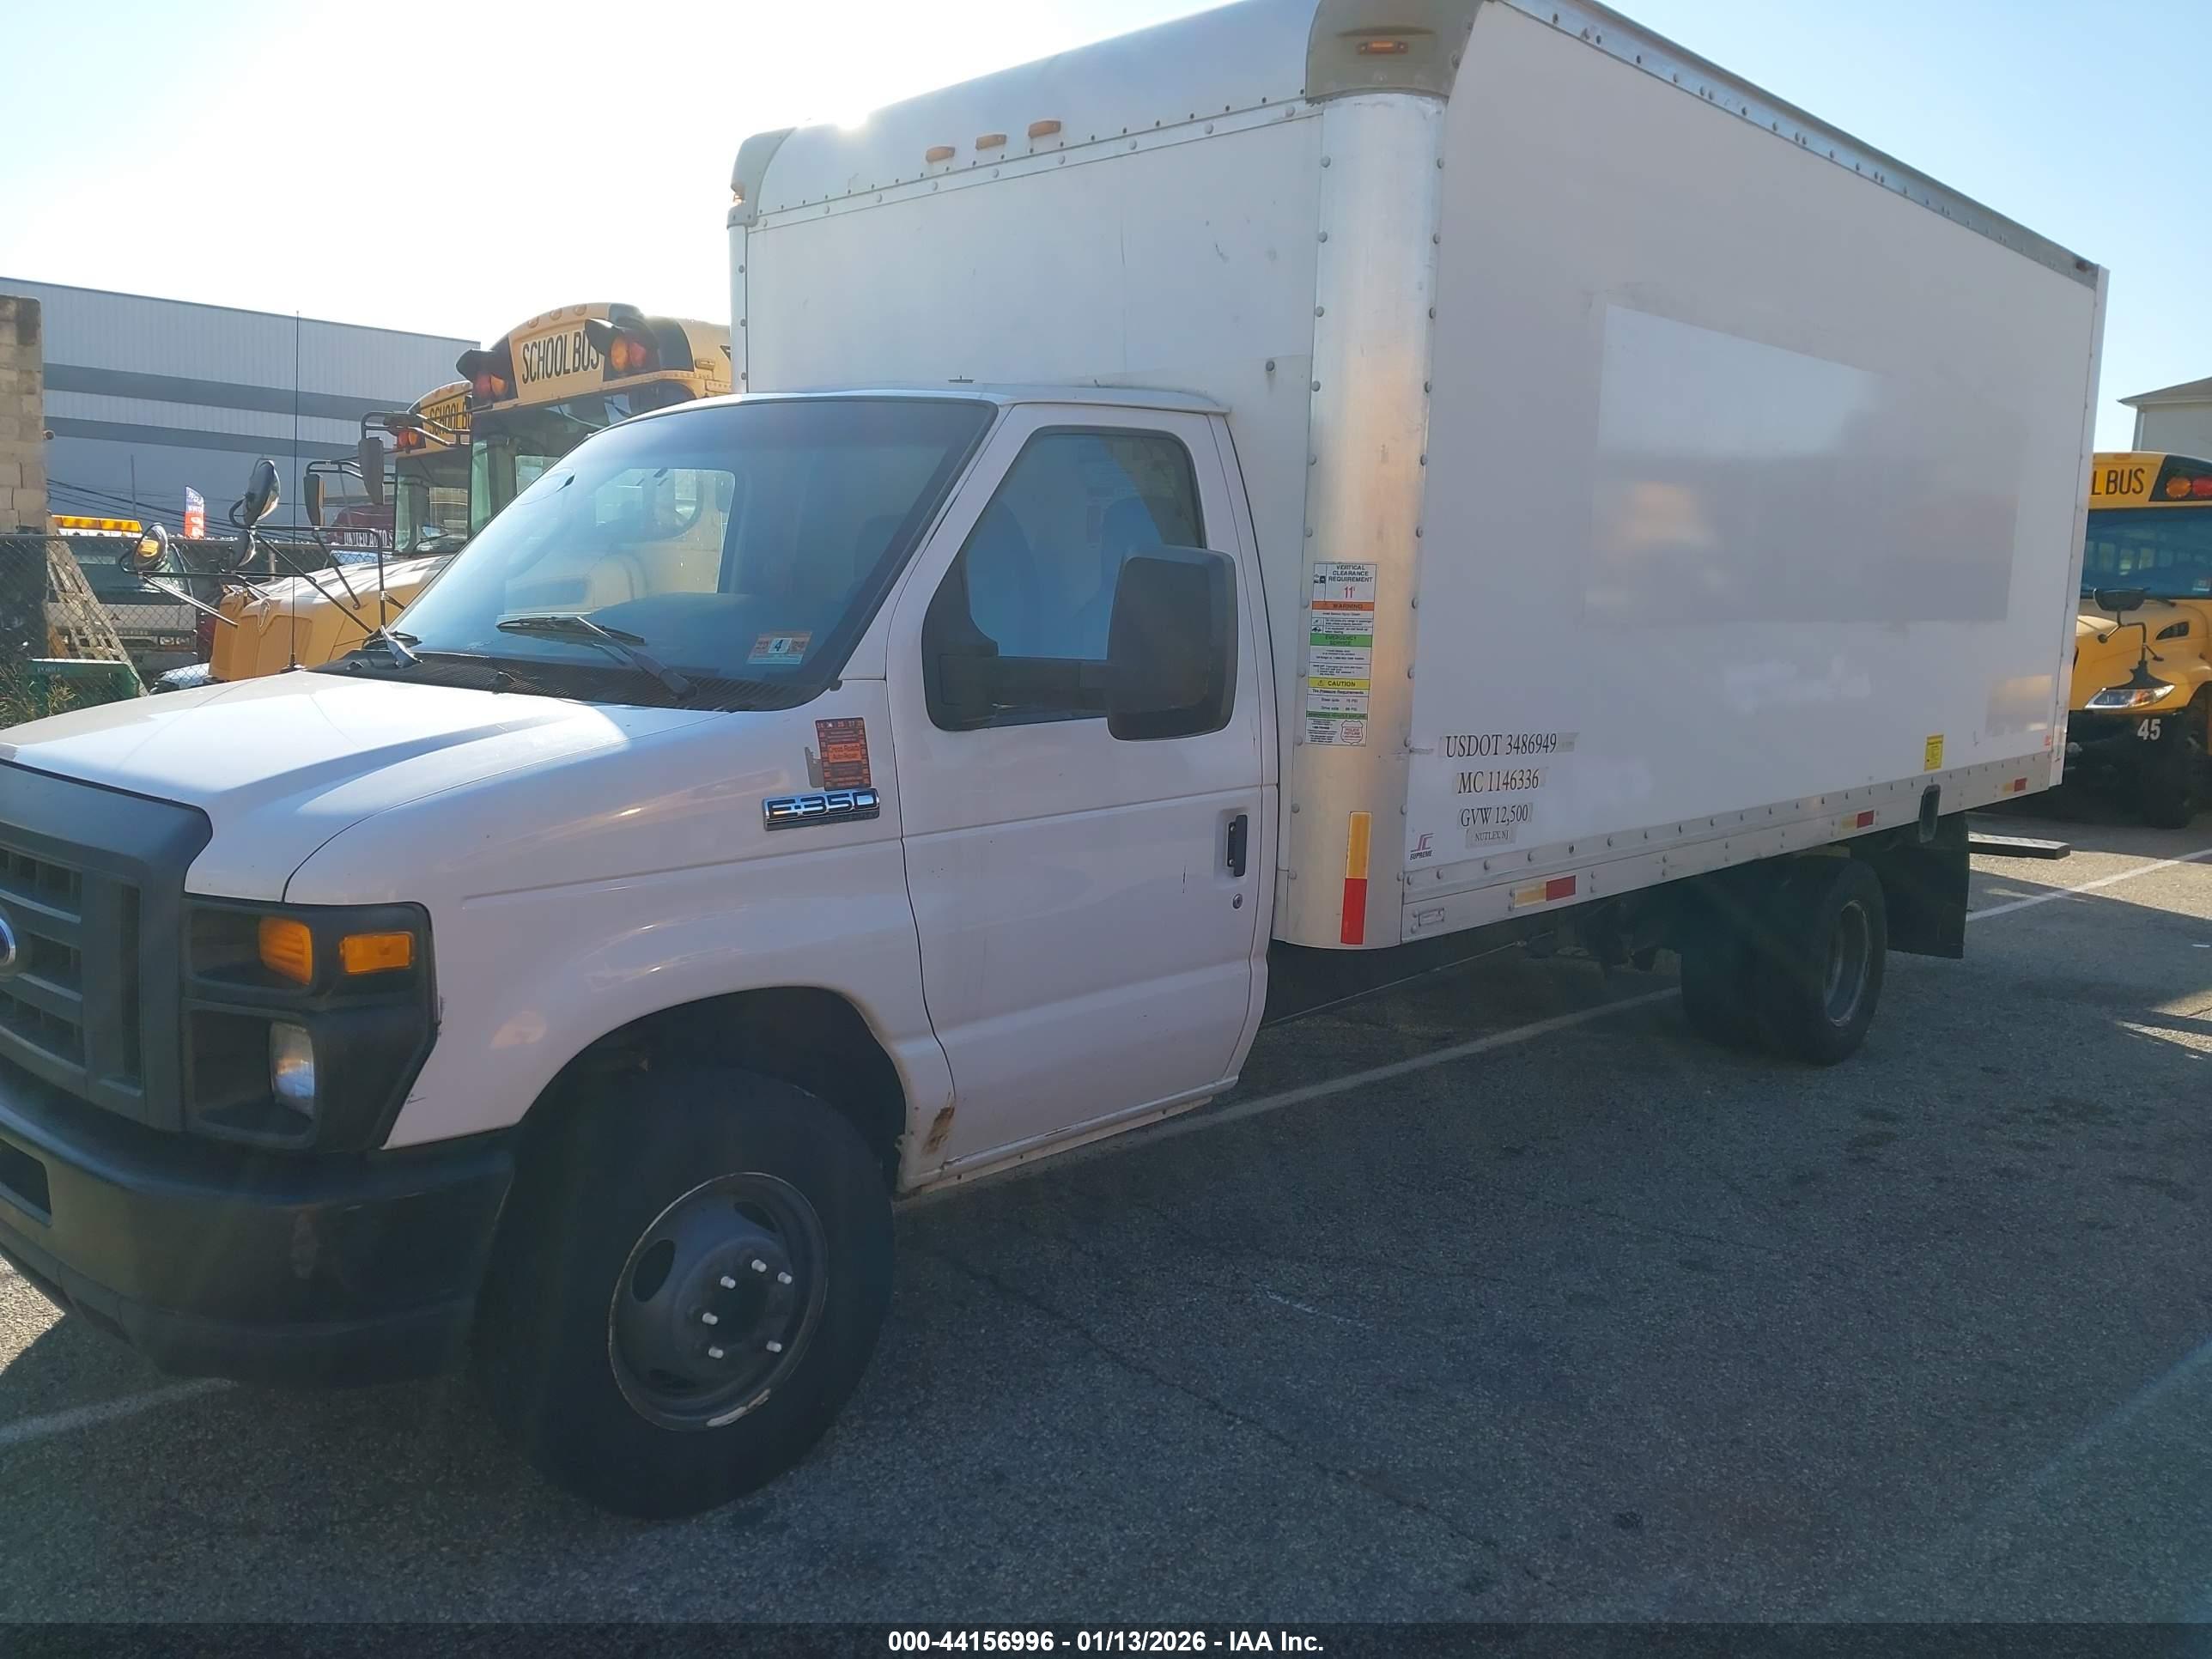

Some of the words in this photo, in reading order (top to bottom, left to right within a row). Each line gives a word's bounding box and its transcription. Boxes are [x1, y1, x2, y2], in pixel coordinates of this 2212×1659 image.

[522, 334, 570, 384] SCHOOL
[573, 331, 599, 373] BUS
[2106, 468, 2145, 495] BUS
[774, 639, 784, 652] 4
[2137, 719, 2160, 740] 45
[1446, 735, 1502, 757] USDOT
[1505, 733, 1557, 755] 3486949
[1457, 772, 1484, 793] MC
[1488, 769, 1539, 791] 1146336
[1461, 807, 1492, 827] GVW
[1495, 805, 1528, 825] 12,500
[1501, 830, 1510, 840] NJ
[1410, 850, 1433, 860] SUPREME
